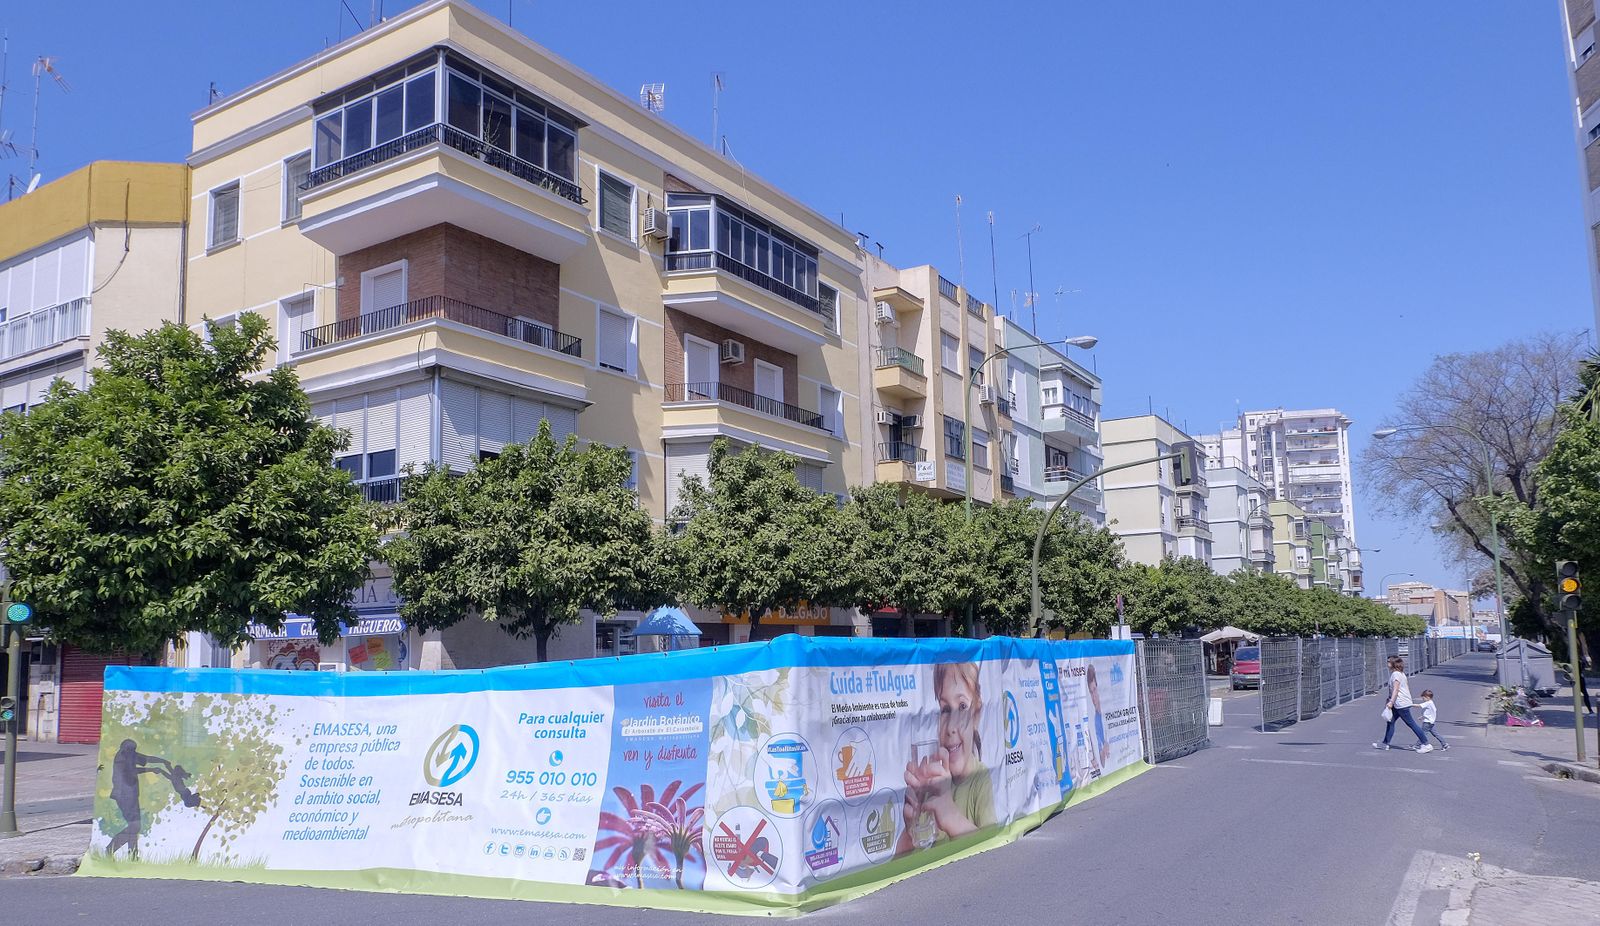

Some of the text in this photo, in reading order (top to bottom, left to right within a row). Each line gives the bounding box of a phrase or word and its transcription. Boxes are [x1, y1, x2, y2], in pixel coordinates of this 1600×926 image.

[829, 669, 916, 697] Cuida #TuAgua
[643, 692, 684, 709] visita el
[831, 704, 837, 714] El
[837, 703, 852, 713] Medio
[852, 702, 875, 712] Ambiente
[889, 700, 896, 709] de
[896, 699, 909, 708] todos
[518, 710, 605, 726] Para cualquier
[628, 711, 700, 728] Jardín Botánico
[831, 711, 896, 727] ¡Gracias por tu colaboración!
[313, 722, 398, 737] EMASESA, una
[534, 726, 587, 739] consulta
[308, 738, 401, 757] empresa pública
[304, 756, 356, 771] de todos.
[623, 744, 698, 770] ven y disfruta
[299, 773, 374, 788] Sostenible en
[505, 769, 598, 787] 955 010 010
[294, 789, 382, 806] el ambito social,
[500, 789, 594, 804] 24h / 365 días
[288, 808, 360, 827] económico y
[282, 825, 371, 841] medioambiental
[491, 826, 588, 840] www.emasesa.com
